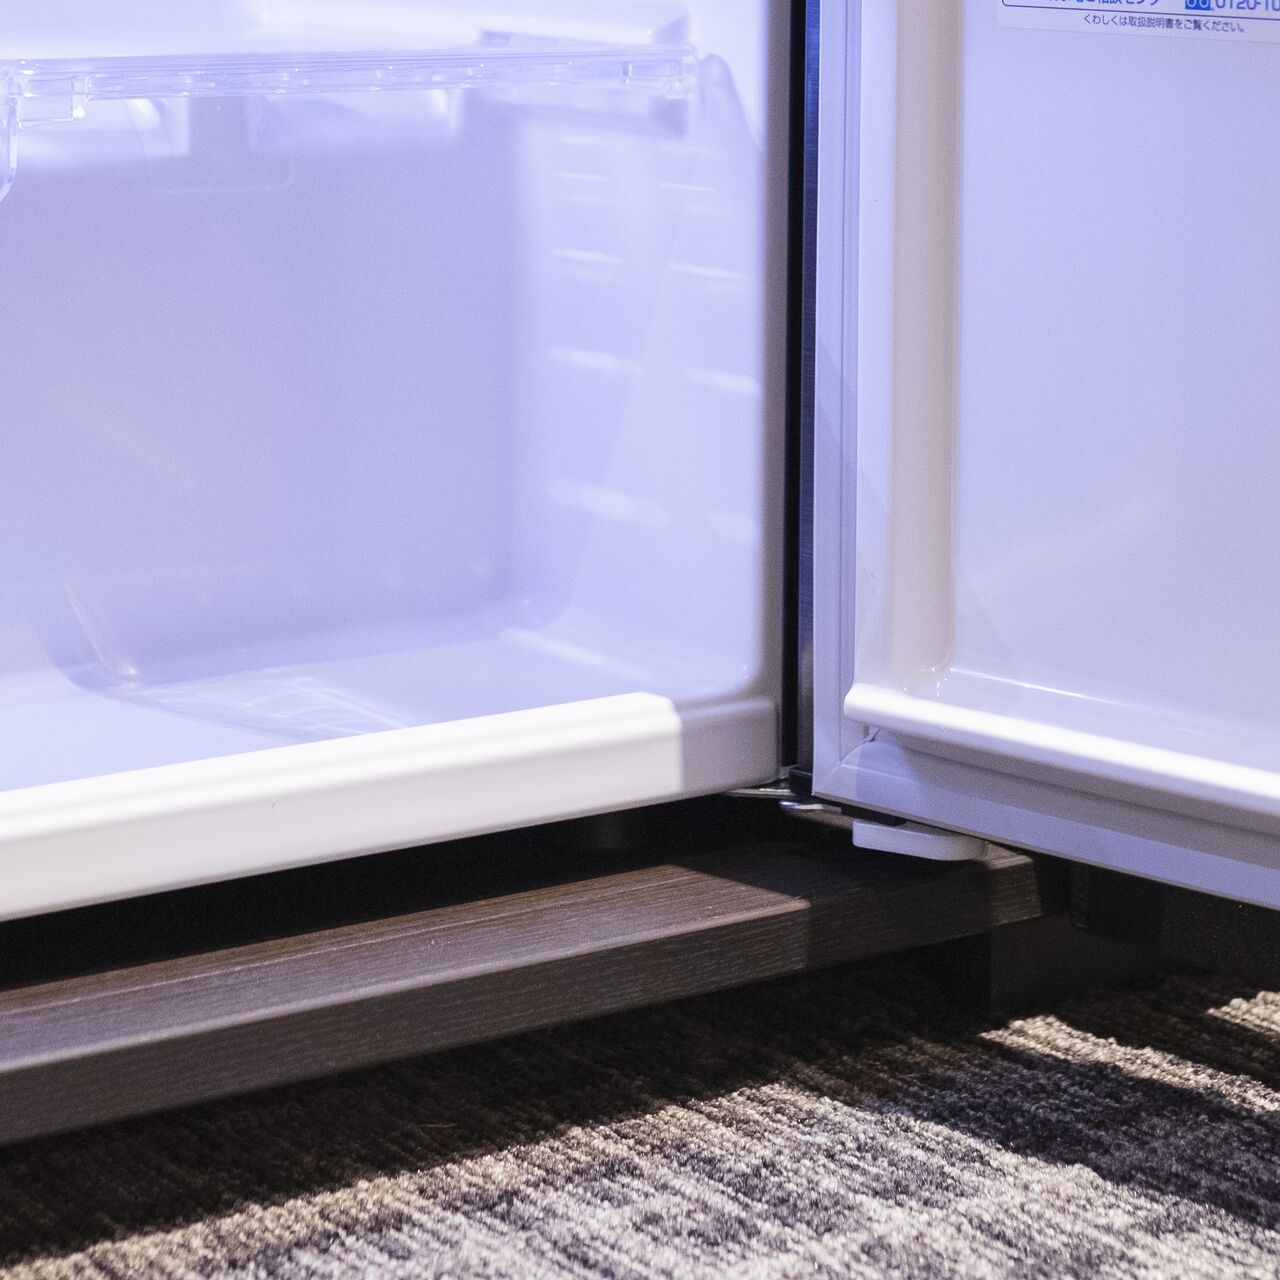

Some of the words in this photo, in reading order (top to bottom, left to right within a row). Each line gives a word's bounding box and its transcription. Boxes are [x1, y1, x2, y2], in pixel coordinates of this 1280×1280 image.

[1083, 13, 1245, 33] くわしくは取扱説明書をご覧ください。
